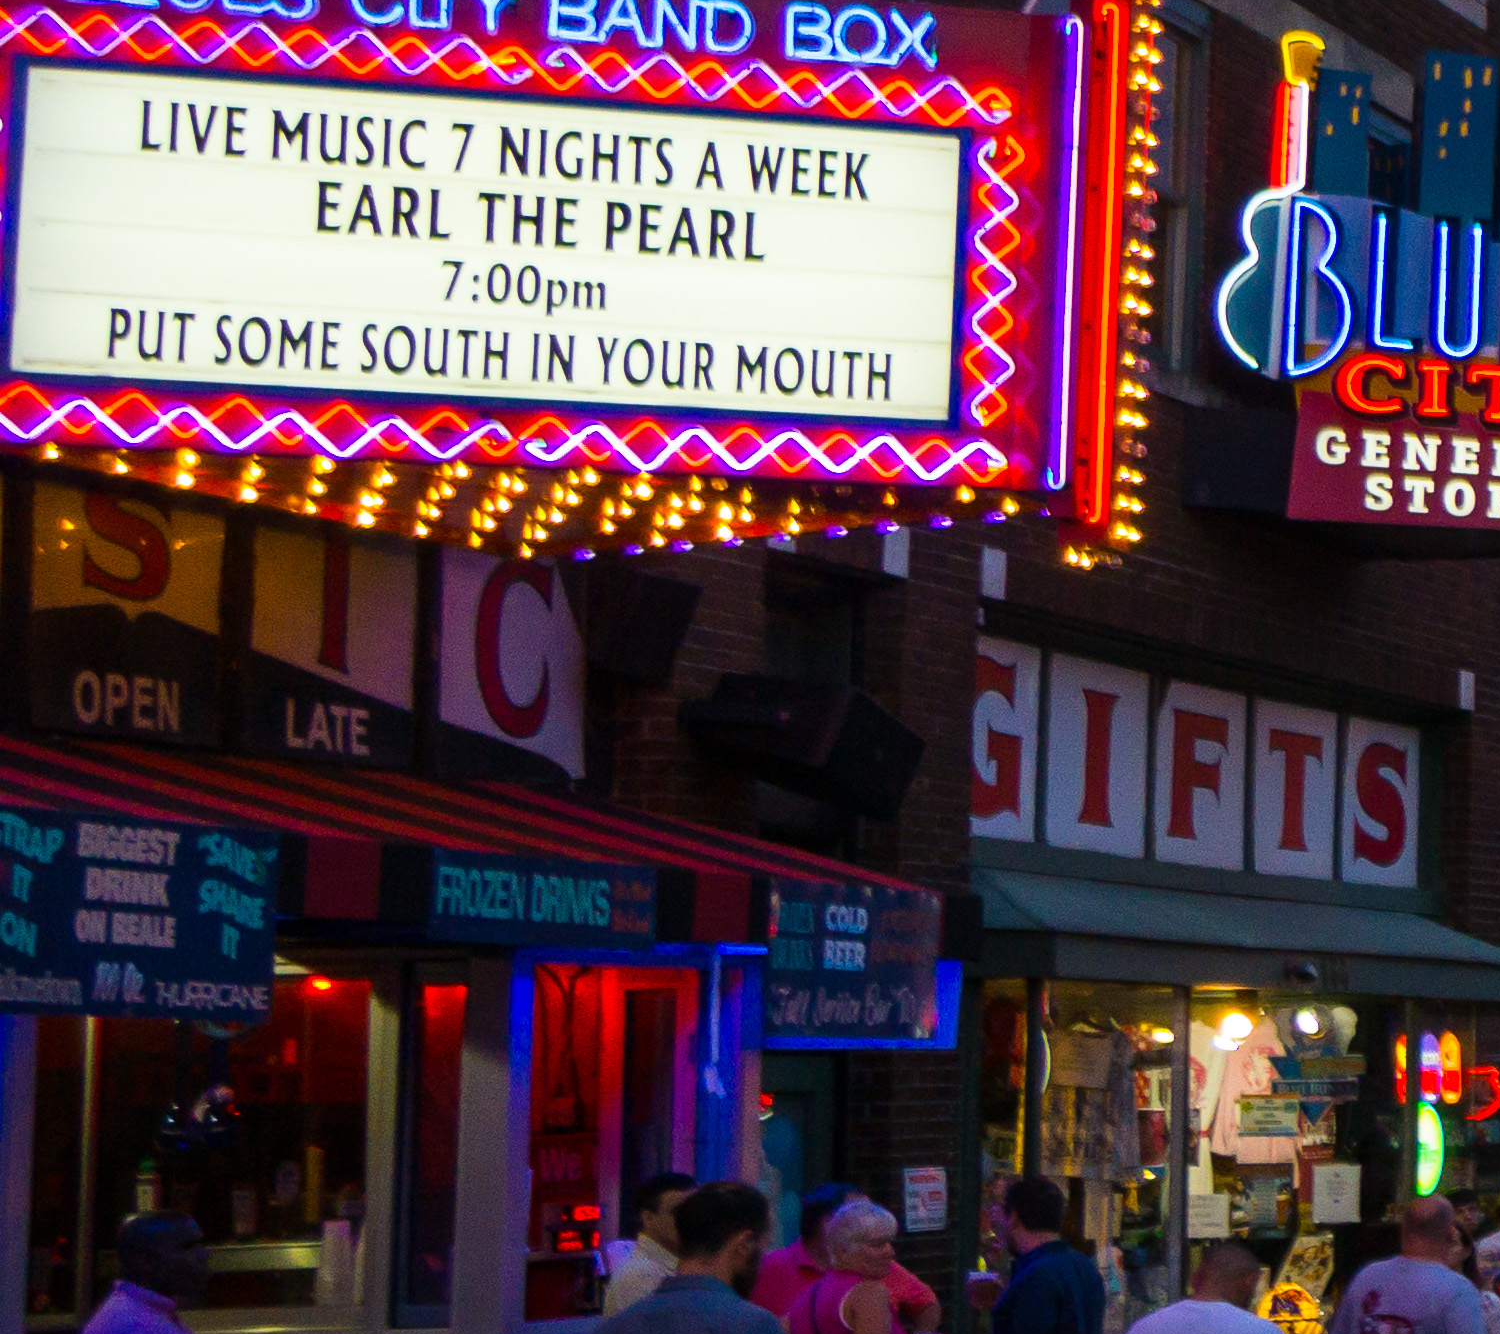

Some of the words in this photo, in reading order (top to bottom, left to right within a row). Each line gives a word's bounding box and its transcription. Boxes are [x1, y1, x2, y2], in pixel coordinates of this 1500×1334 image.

[783, 2, 938, 69] BOX
[140, 99, 248, 155] LIVE
[271, 110, 424, 172] MUSIC
[450, 123, 473, 174] 7
[498, 126, 674, 187] NIGHTS
[695, 144, 726, 191] A
[746, 144, 872, 202] WEEK
[316, 181, 452, 243] EARL
[478, 192, 579, 249] THE
[604, 201, 767, 261] PEARL
[440, 260, 608, 316] 7:00pm
[107, 308, 196, 362] PUT
[213, 314, 341, 372] SOME
[360, 320, 505, 382] SOUTH
[530, 333, 574, 384] IN
[597, 335, 715, 391] YOUR
[735, 345, 893, 402] MOUTH
[73, 672, 181, 731] OPEN
[283, 698, 370, 756] LATE
[970, 653, 1407, 868] GIFTS
[77, 821, 181, 866] BIGGEST
[84, 867, 170, 907] DRINK
[437, 866, 526, 920] FROZEN
[531, 872, 611, 927] DRINKS
[73, 909, 107, 944] ON
[111, 911, 177, 949] BEALE
[825, 903, 869, 934] COLD
[823, 938, 867, 972] BEER
[155, 979, 268, 1010] HURRICANE
